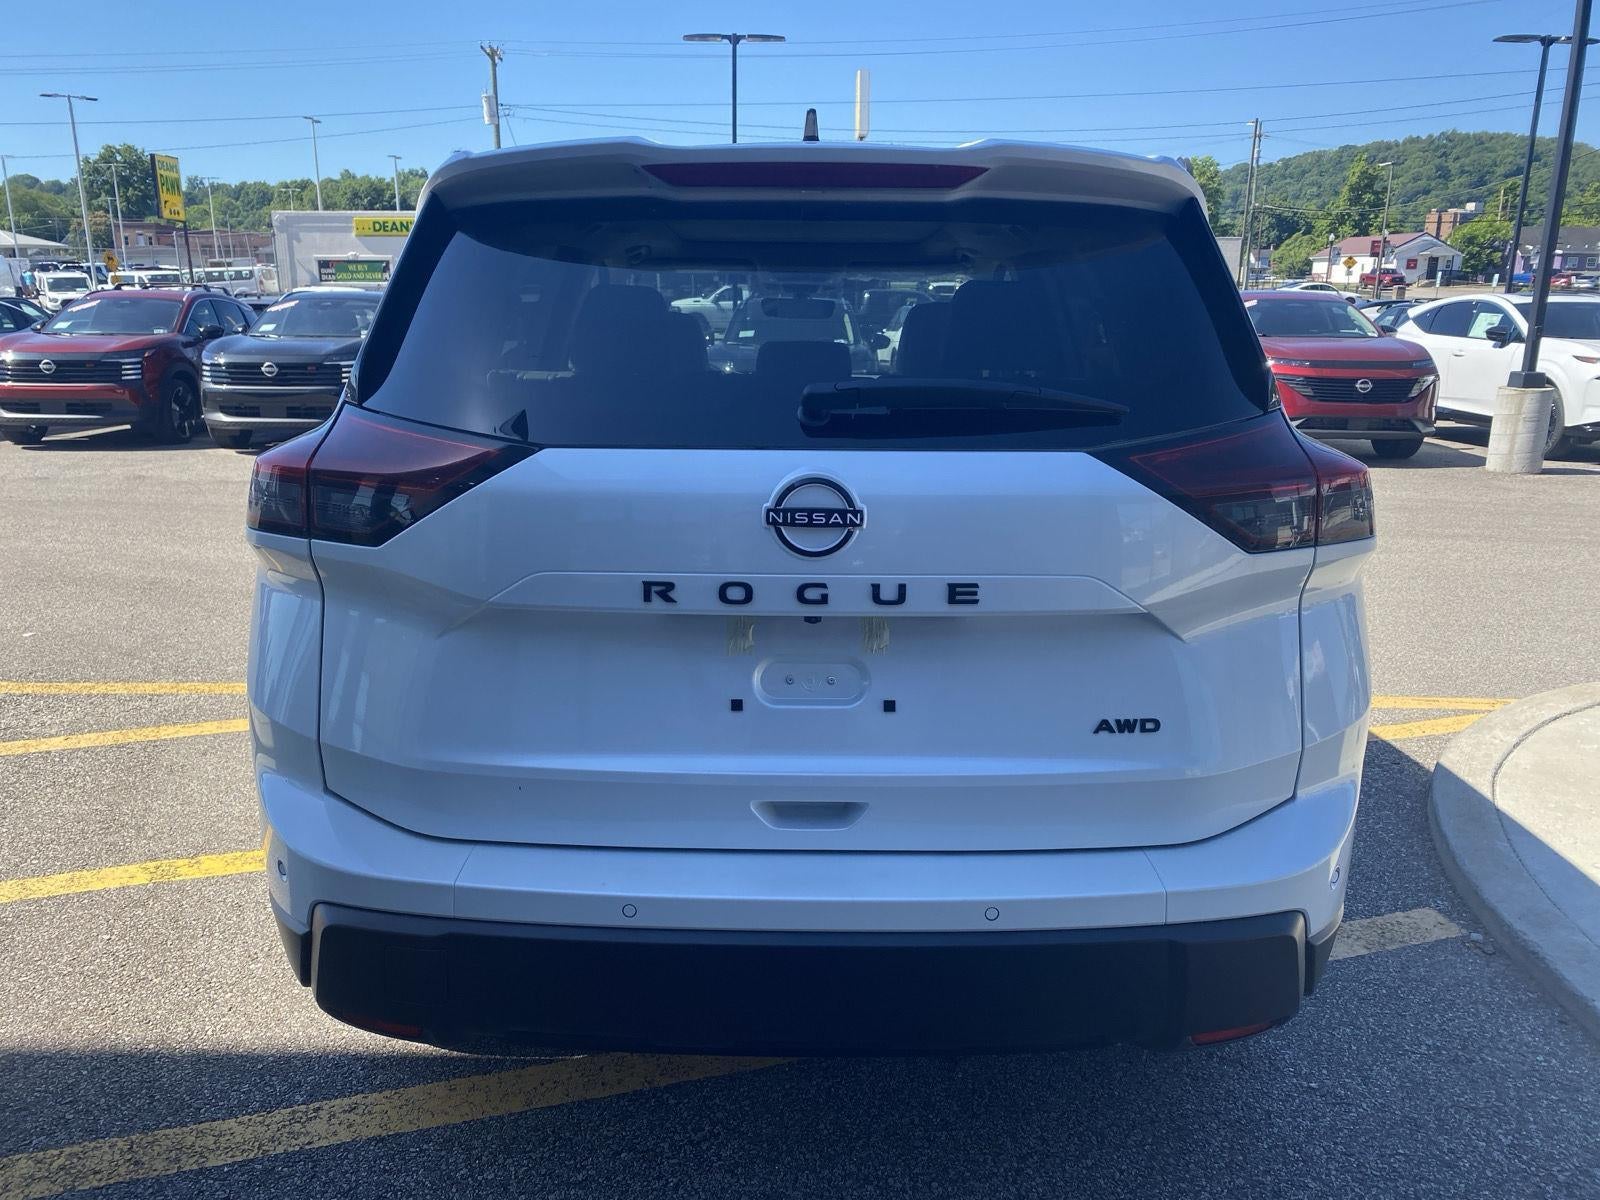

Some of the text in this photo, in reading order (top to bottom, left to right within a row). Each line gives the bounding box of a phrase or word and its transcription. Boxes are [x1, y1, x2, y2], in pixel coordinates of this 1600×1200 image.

[160, 174, 181, 196] PAWN
[769, 511, 861, 525] NISSAN
[642, 580, 982, 606] ROGUE
[1093, 717, 1162, 735] AWD
